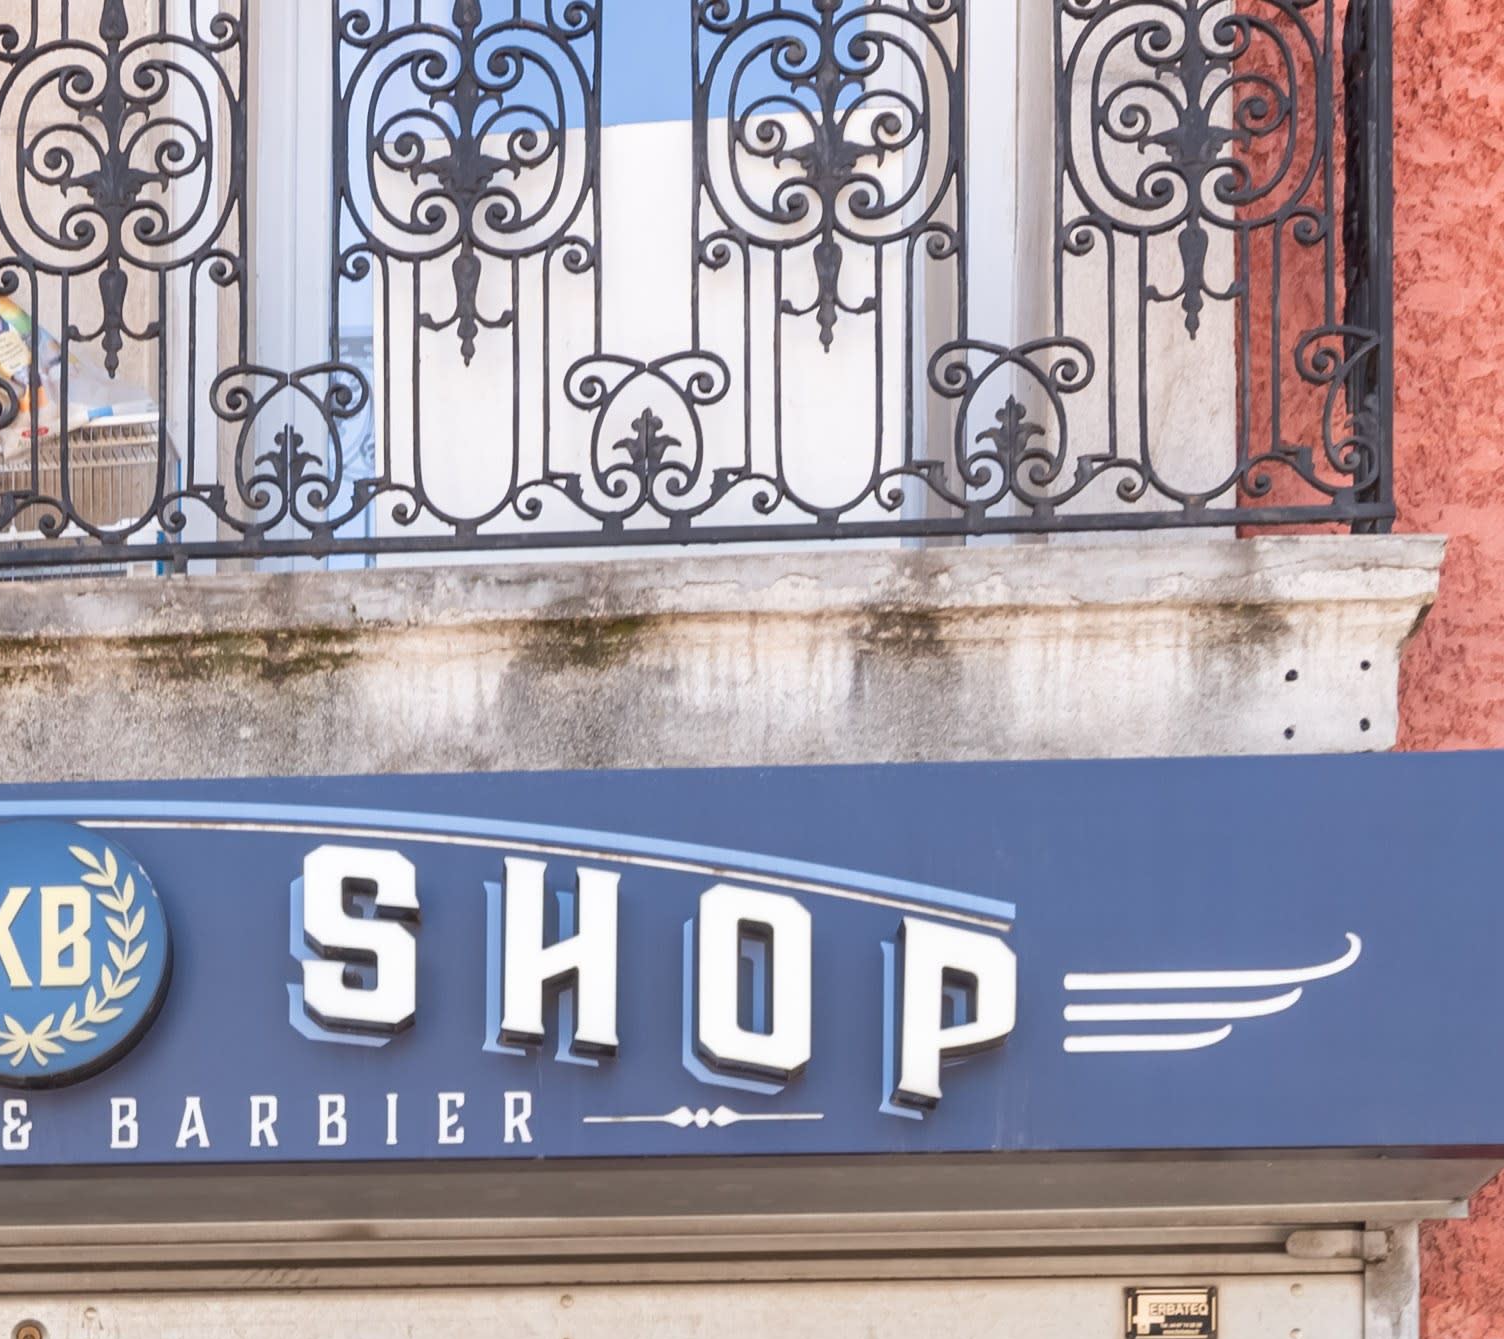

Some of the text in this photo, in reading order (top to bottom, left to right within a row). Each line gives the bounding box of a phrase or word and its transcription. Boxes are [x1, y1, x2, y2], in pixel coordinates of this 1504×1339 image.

[294, 844, 1017, 1108] SHOP
[0, 1096, 33, 1151] &
[110, 1089, 534, 1149] BARBIER
